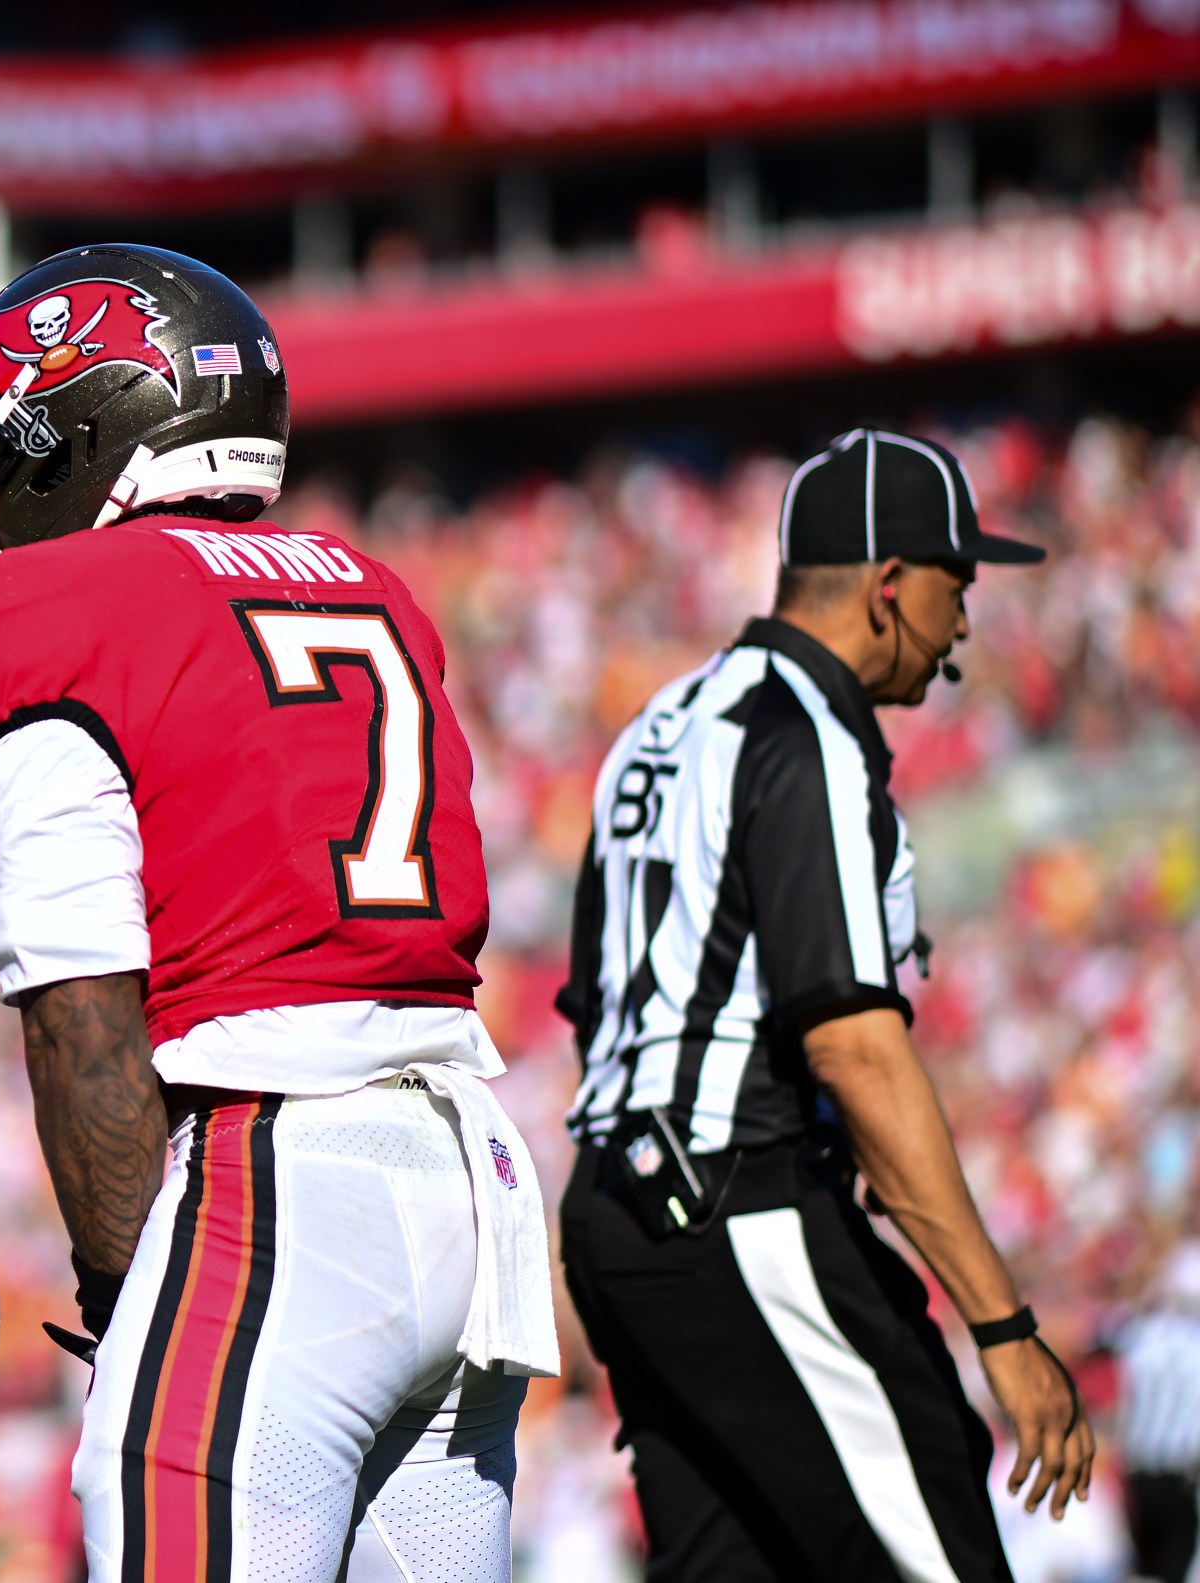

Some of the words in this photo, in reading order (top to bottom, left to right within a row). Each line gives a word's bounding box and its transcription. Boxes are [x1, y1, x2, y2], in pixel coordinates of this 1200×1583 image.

[228, 449, 266, 465] CHOOSE
[266, 454, 282, 467] LOVE
[160, 528, 364, 583] IRVING
[228, 598, 445, 920] 7
[492, 1156, 516, 1184] NFL
